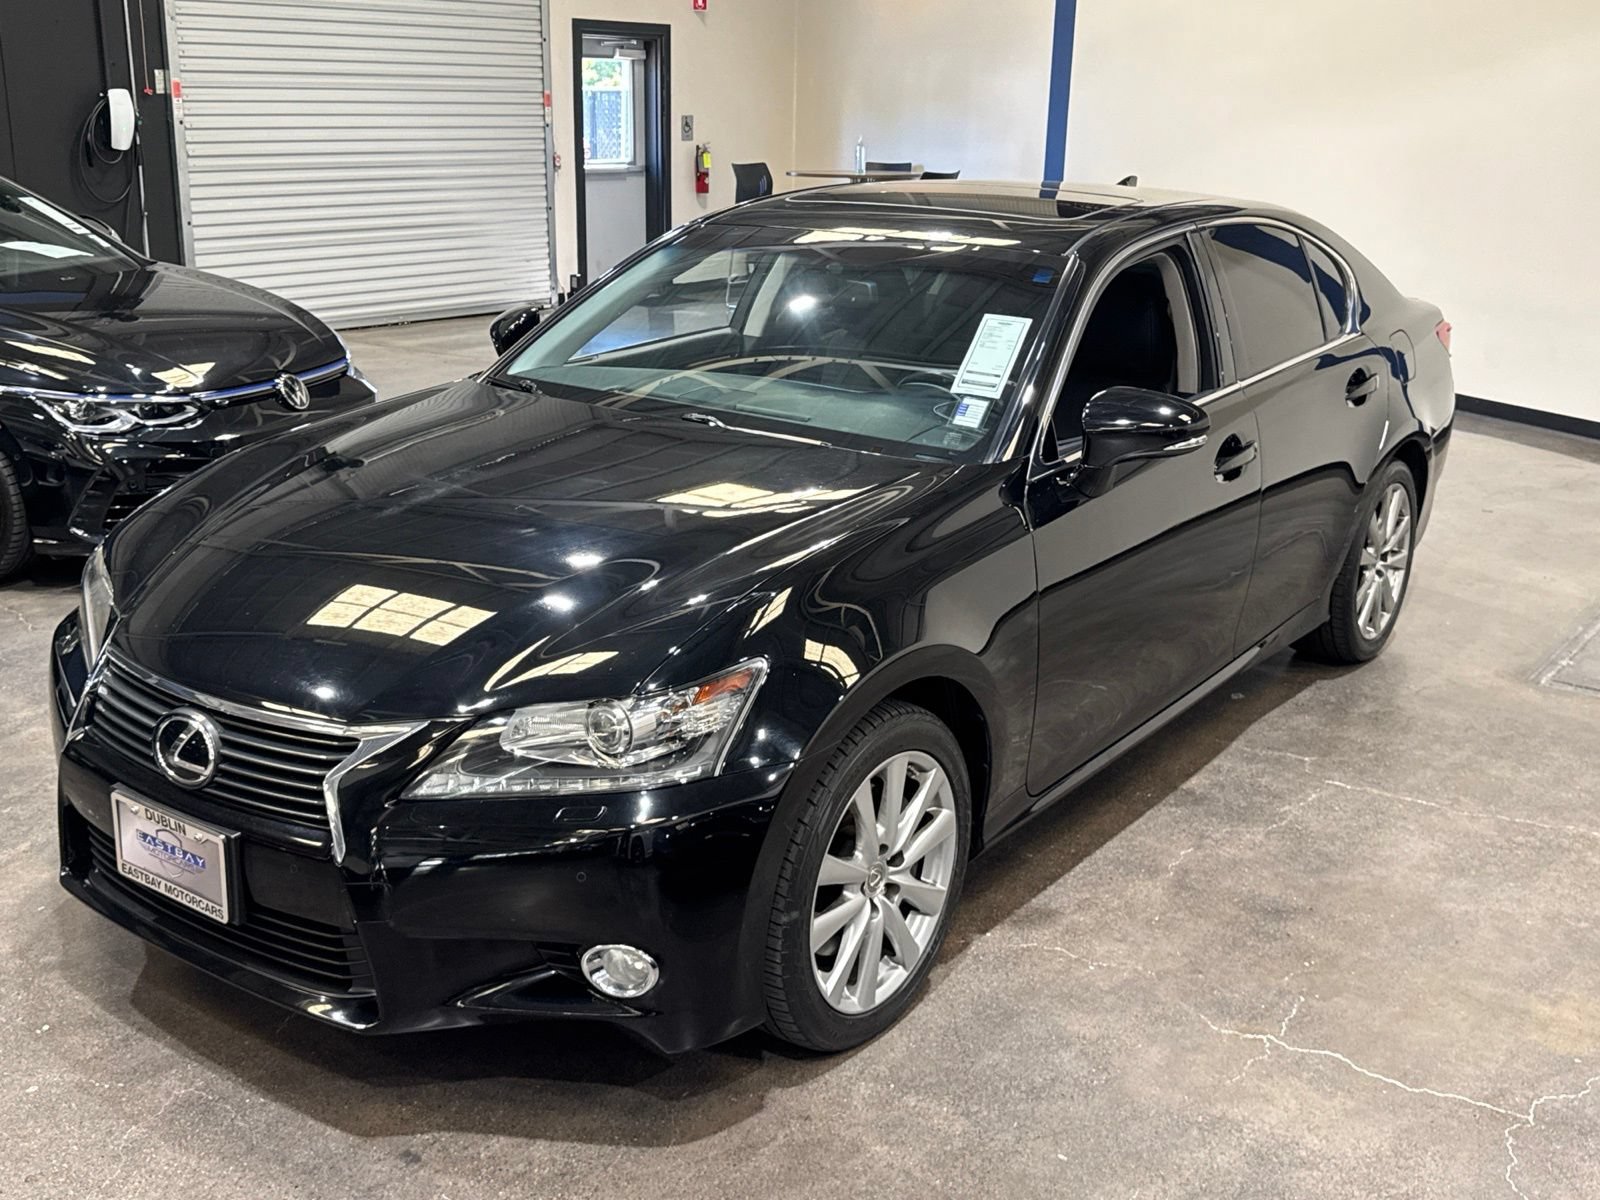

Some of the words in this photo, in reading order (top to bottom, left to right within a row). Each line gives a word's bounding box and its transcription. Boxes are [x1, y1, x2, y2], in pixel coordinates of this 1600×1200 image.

[144, 808, 187, 836] DUBLIN
[137, 831, 205, 868] EASTBAY
[121, 862, 162, 889] EASTBAY
[164, 884, 224, 920] MOTORCARS
